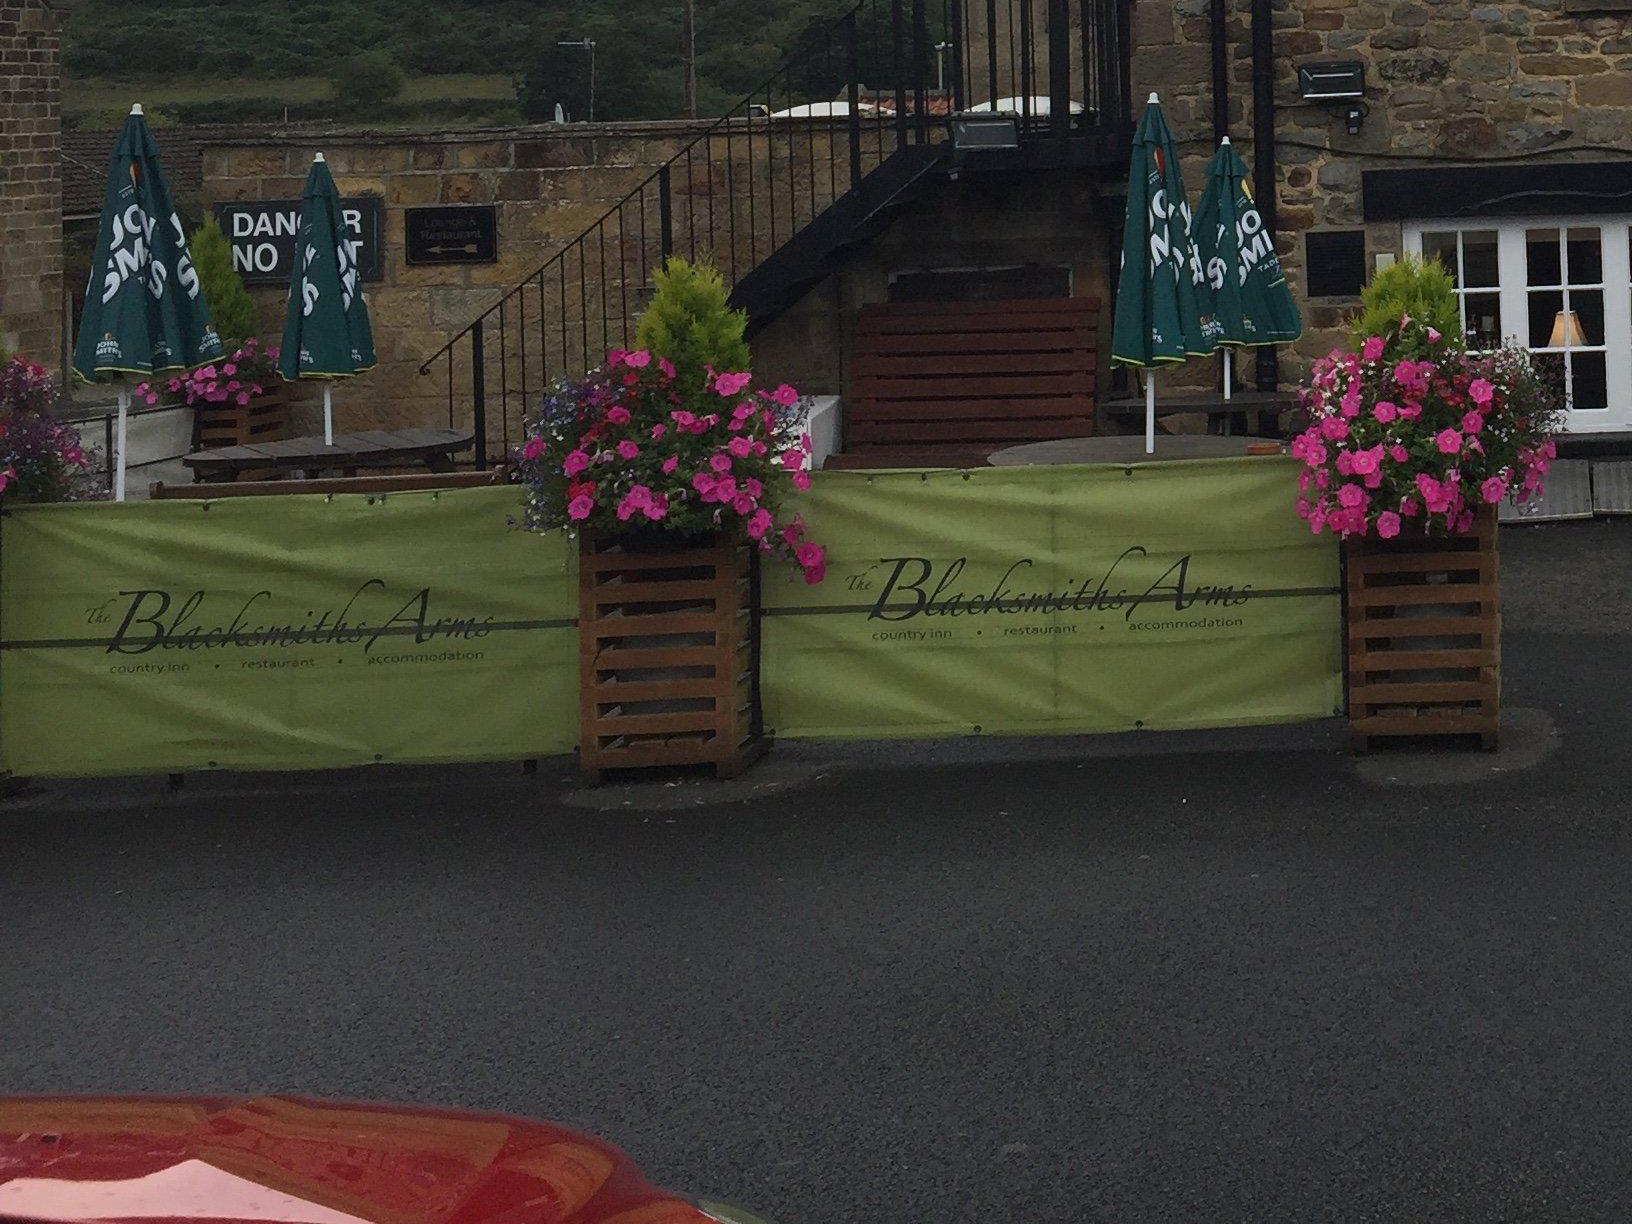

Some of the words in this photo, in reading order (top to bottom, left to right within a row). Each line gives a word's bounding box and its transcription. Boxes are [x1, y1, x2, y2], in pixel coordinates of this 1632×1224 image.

[233, 209, 362, 237] DANR
[420, 230, 483, 241] Restaurant
[232, 242, 279, 273] NO
[844, 565, 877, 591] The
[866, 546, 1146, 621] Blacksmiths
[1125, 554, 1252, 621] Arms
[84, 598, 117, 625] The
[105, 578, 385, 655] Blacksmiths
[364, 586, 495, 654] Arms
[1002, 624, 1078, 637] restaurant
[1128, 617, 1243, 631] accommodation
[871, 630, 927, 642] country
[929, 628, 953, 640] inn
[240, 657, 316, 670] restaurant
[367, 650, 485, 665] accommodation
[109, 662, 166, 675] country
[167, 662, 190, 672] inn
